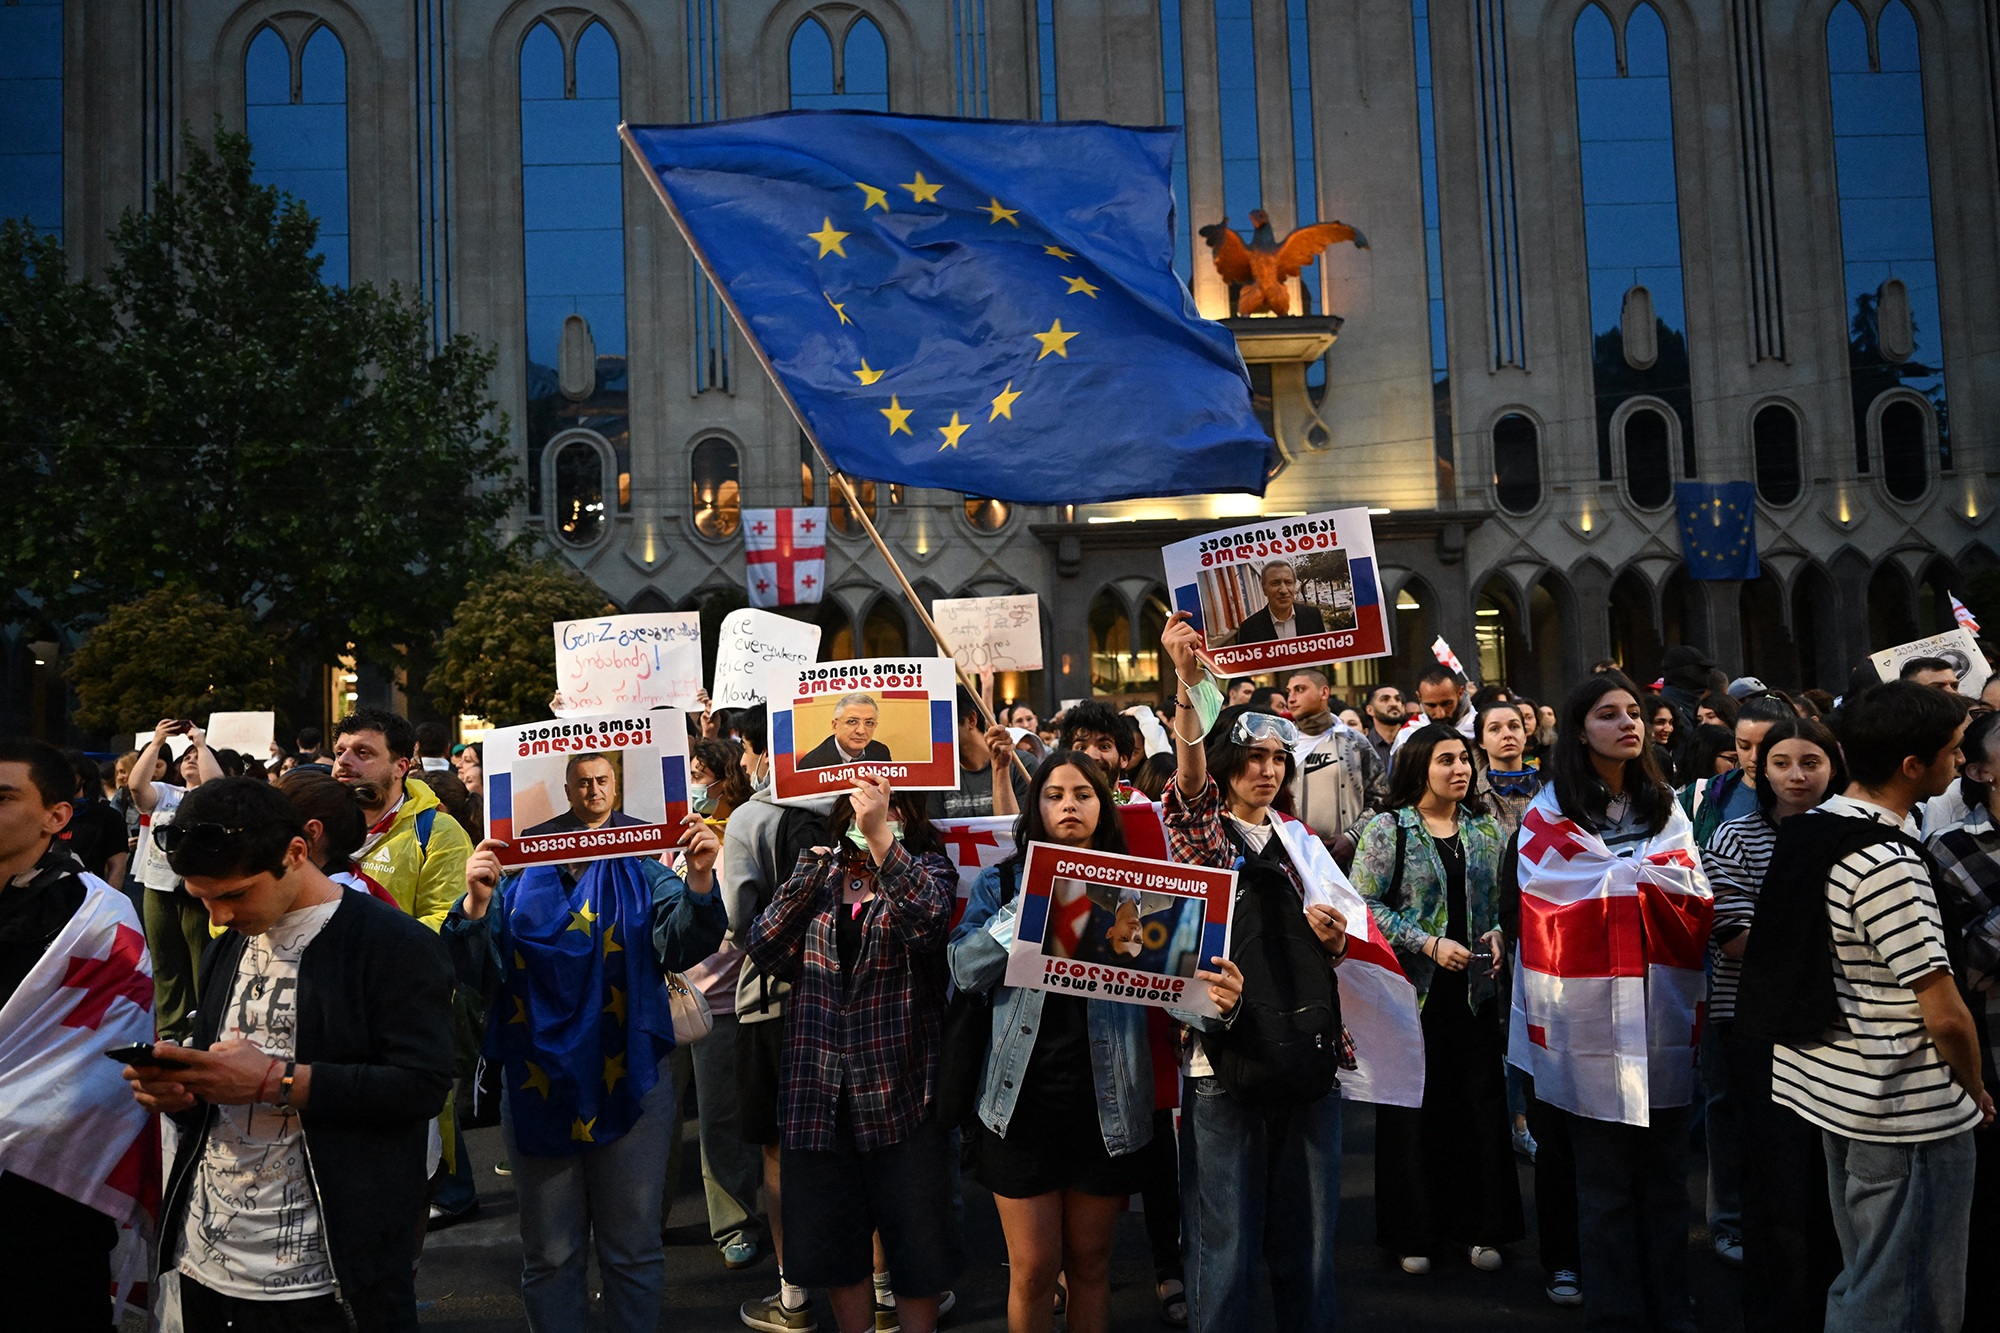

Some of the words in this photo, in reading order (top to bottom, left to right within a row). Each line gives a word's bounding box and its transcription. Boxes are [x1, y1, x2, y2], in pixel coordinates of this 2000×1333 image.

[1199, 528, 1277, 553] პუტინის
[1281, 518, 1336, 538] მონა!
[1200, 532, 1338, 567] მოღალატე!
[563, 622, 617, 650] Gen-Z
[1213, 647, 1262, 667] რესან
[1266, 634, 1355, 659] კონცელიძე
[798, 667, 868, 682] პუტინის
[873, 663, 922, 676] მონა!
[798, 675, 923, 696] მოღალატე!
[518, 722, 593, 743] პუტინის
[598, 717, 652, 734] მონა!
[518, 730, 653, 757] მოღალატე!
[1305, 752, 1332, 765] NIKE
[818, 767, 856, 784] ისკო
[520, 835, 576, 854] სამველ
[579, 828, 662, 848] მანუკიანი
[1056, 860, 1144, 886] ჩაკვეტაძე
[1145, 873, 1209, 894] გიორგი
[1043, 973, 1098, 992] მონა!
[1045, 958, 1186, 992] მოღალატე!
[1103, 983, 1183, 1003] პუტინის
